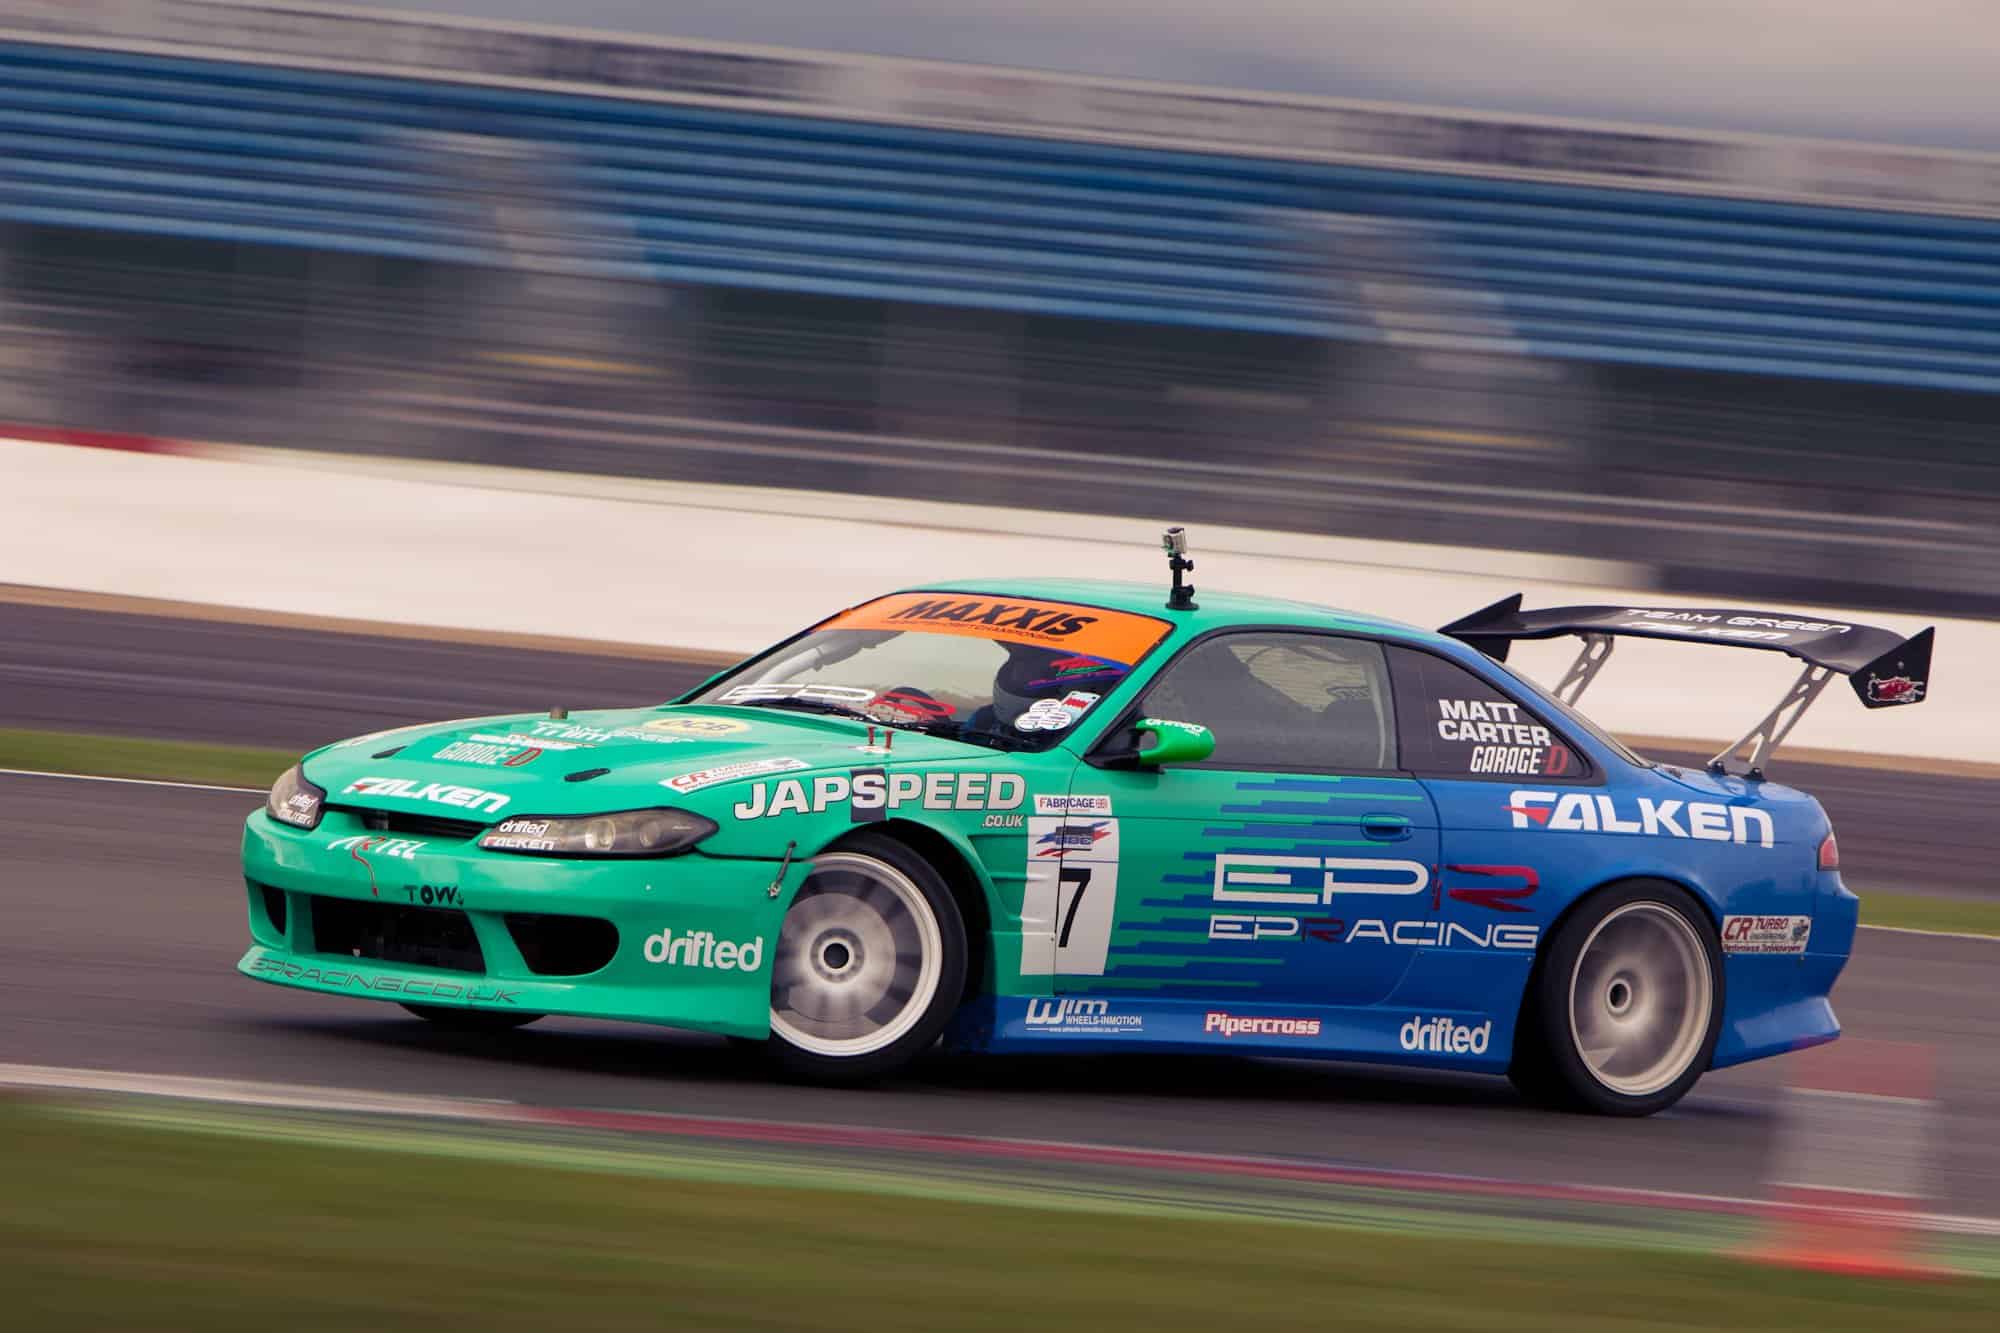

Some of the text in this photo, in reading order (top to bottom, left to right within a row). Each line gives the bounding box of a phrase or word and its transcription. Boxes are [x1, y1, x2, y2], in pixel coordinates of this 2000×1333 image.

[889, 600, 1099, 636] MAXXIS
[1625, 609, 1853, 634] TEAM GREEN
[1438, 699, 1519, 723] MATT
[1437, 720, 1552, 747] CARTER
[341, 777, 512, 813] FALKEN
[733, 771, 1027, 821] JAPSPEED
[1039, 797, 1096, 809] FABRICAGE
[499, 820, 550, 834] drifted
[1502, 789, 1775, 849] FALKEN
[1212, 853, 1541, 912] EPR
[1058, 867, 1092, 948] 7
[1208, 914, 1541, 949] EPRACING
[1723, 917, 1754, 941] CR
[643, 927, 764, 972] drifted
[1205, 1012, 1322, 1036] Pipercross
[1400, 1016, 1492, 1055] drifted
